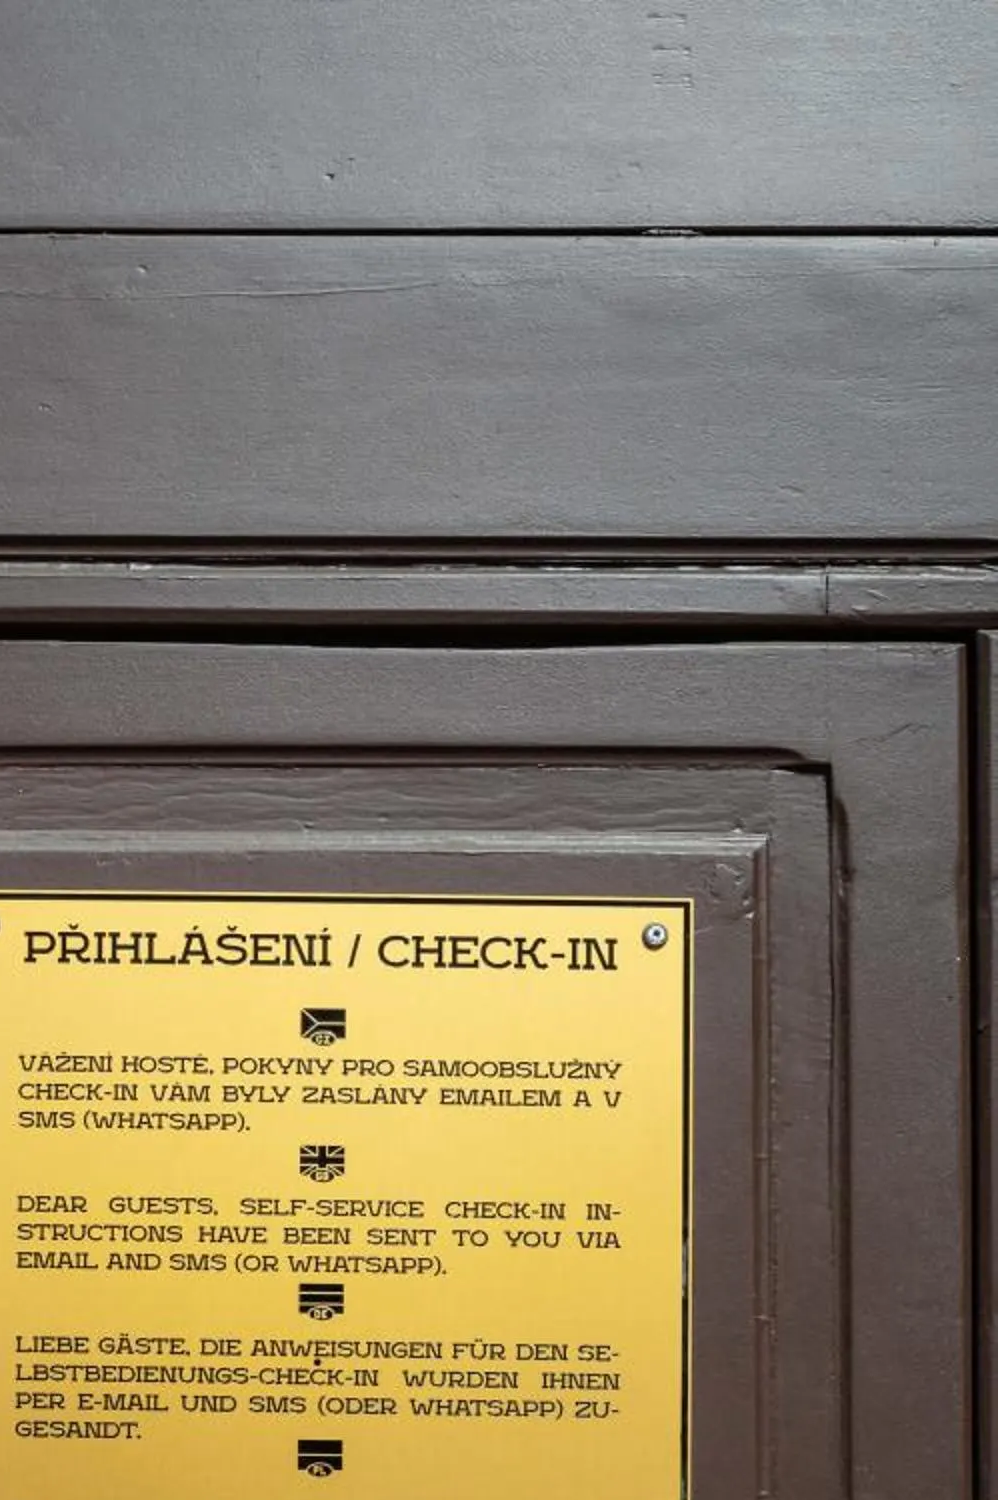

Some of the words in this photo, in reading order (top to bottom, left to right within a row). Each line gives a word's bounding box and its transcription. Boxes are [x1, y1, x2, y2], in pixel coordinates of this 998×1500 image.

[23, 923, 333, 967] PŘIHLÁŠENÍ
[347, 933, 363, 969] /
[377, 935, 619, 971] CHECK-IN
[221, 1056, 335, 1076] POKYNY
[341, 1057, 395, 1077] PRO
[17, 1082, 139, 1102] CHECK-IN
[221, 1084, 292, 1104] BYLY
[438, 1087, 563, 1108] EMAILEM
[572, 1089, 593, 1108] A
[603, 1090, 623, 1110] V
[17, 1110, 76, 1129] SMS
[83, 1110, 251, 1132] (WHATSAPP).
[16, 1195, 88, 1213] DEAR
[108, 1196, 219, 1216] GUESTS,
[239, 1198, 425, 1218] SELF-SERVICE
[444, 1201, 567, 1220] CHECK-IN
[585, 1202, 622, 1222] IN-
[16, 1223, 183, 1243] STRUCTIONS
[197, 1225, 268, 1245] HAVE
[282, 1226, 351, 1246] BEEN
[366, 1227, 438, 1247] SENT
[451, 1229, 490, 1248] TO
[503, 1230, 562, 1249] YOU
[575, 1230, 622, 1249] VIA
[15, 1251, 99, 1271] EMAIL
[105, 1252, 162, 1272] AND
[169, 1252, 227, 1272] SMS
[233, 1253, 280, 1275] (OR
[287, 1254, 448, 1276] WHATSAPP).
[15, 1335, 90, 1355] LIEBE
[97, 1333, 191, 1357] GÄSTE,
[199, 1338, 243, 1357] DIE
[249, 1339, 443, 1361] ANWEISUNGEN
[451, 1337, 507, 1361] FÜR
[515, 1343, 569, 1362] DEN
[577, 1343, 619, 1363] SE-
[15, 1364, 379, 1386] LBSTBEDIENUNGS-CHECK-IN
[401, 1370, 519, 1390] WURDEN
[541, 1371, 621, 1391] IHNEN
[14, 1391, 66, 1410] PER
[77, 1392, 170, 1412] E-MAIL
[180, 1394, 238, 1413] UND
[248, 1395, 307, 1414] SMS
[317, 1395, 399, 1417] (ODER
[409, 1398, 565, 1420] WHATSAPP)
[574, 1401, 619, 1419] ZU-
[14, 1420, 142, 1440] GESANDT.
